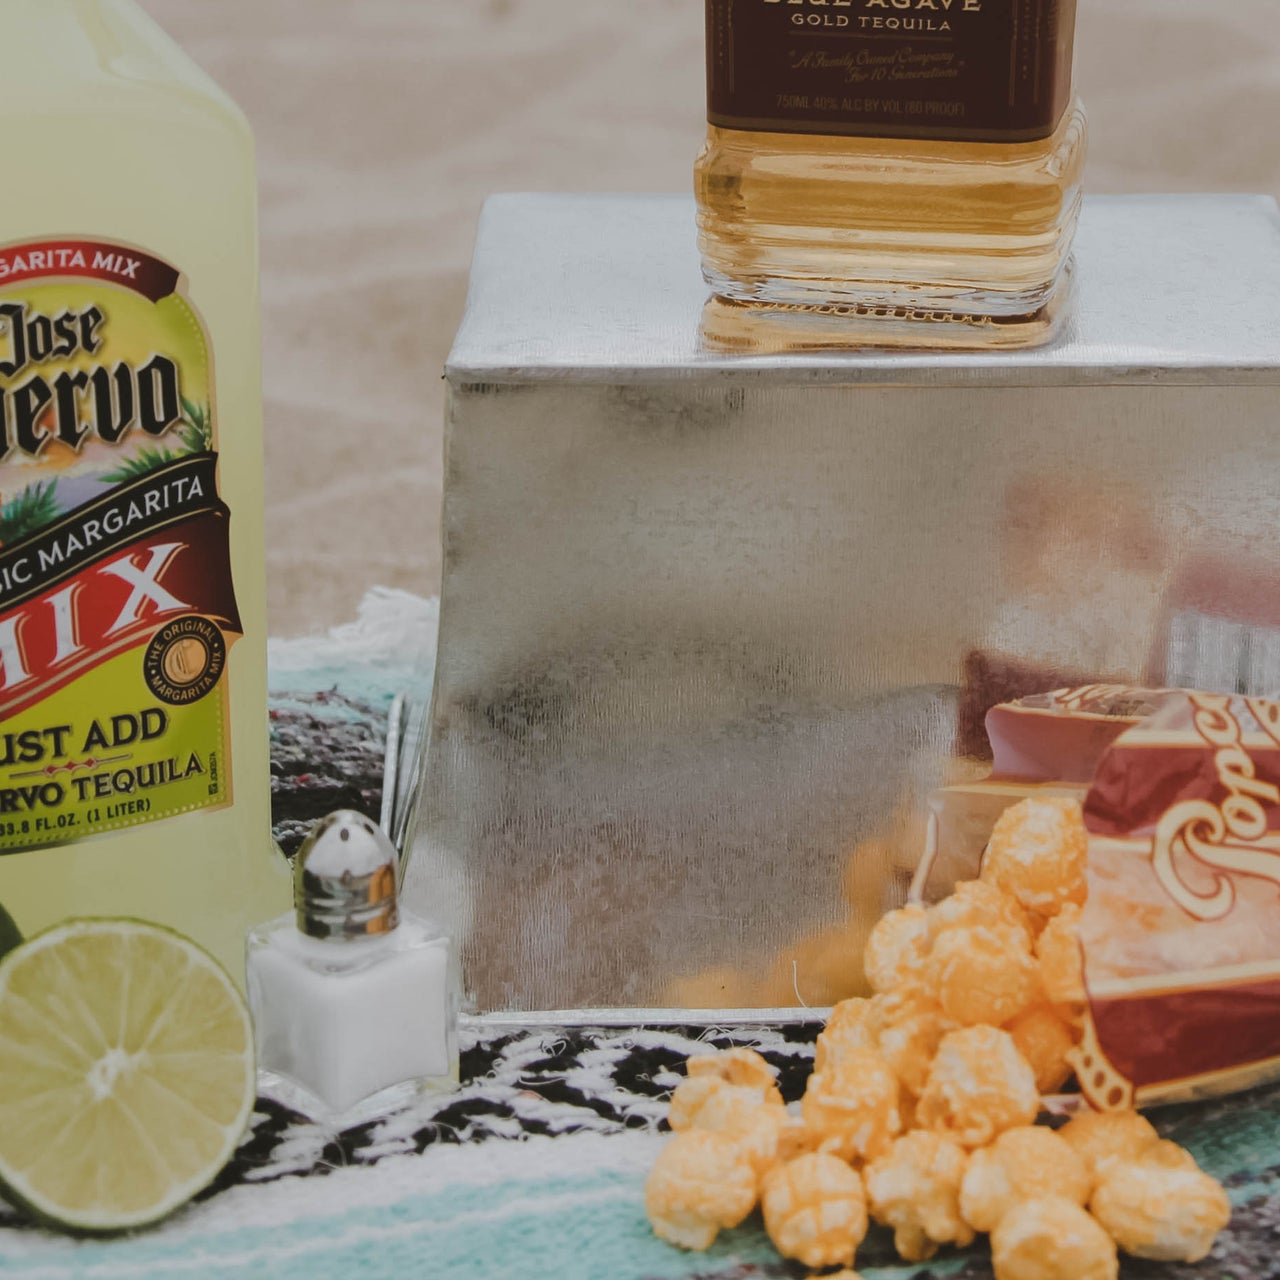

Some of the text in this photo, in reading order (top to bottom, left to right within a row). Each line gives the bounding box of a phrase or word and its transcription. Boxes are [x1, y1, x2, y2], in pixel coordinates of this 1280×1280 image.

[791, 13, 952, 31] GOLD TEQUILA
[864, 98, 880, 113] BY
[90, 250, 141, 280] MIX
[37, 475, 204, 571] MARGARITA
[148, 620, 215, 668] THE ORIGINAL
[151, 650, 222, 701] MARGARITA MIX
[82, 707, 169, 753] ADD
[71, 752, 205, 801] TEQUILA
[106, 797, 152, 821] LITER)
